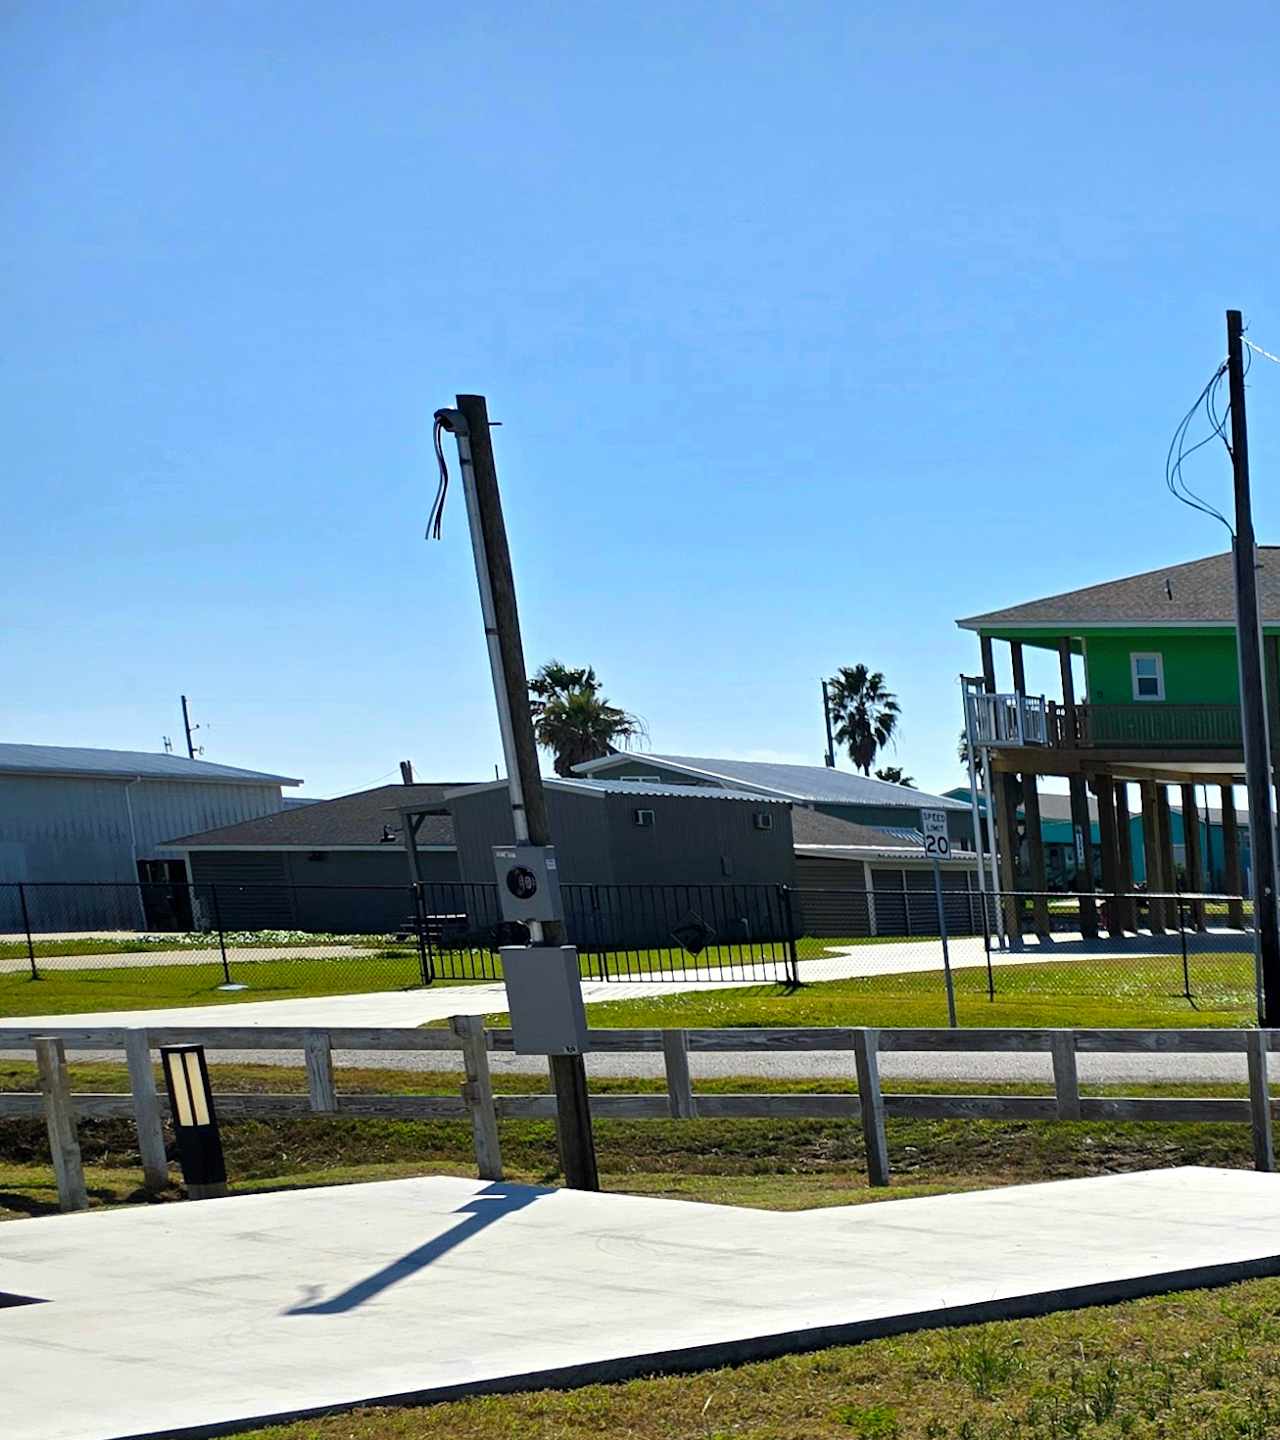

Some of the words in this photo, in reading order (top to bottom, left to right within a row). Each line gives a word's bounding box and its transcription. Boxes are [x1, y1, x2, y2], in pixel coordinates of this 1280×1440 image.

[923, 813, 945, 822] SPEED
[926, 824, 944, 832] LIMIT
[926, 835, 948, 854] 20
